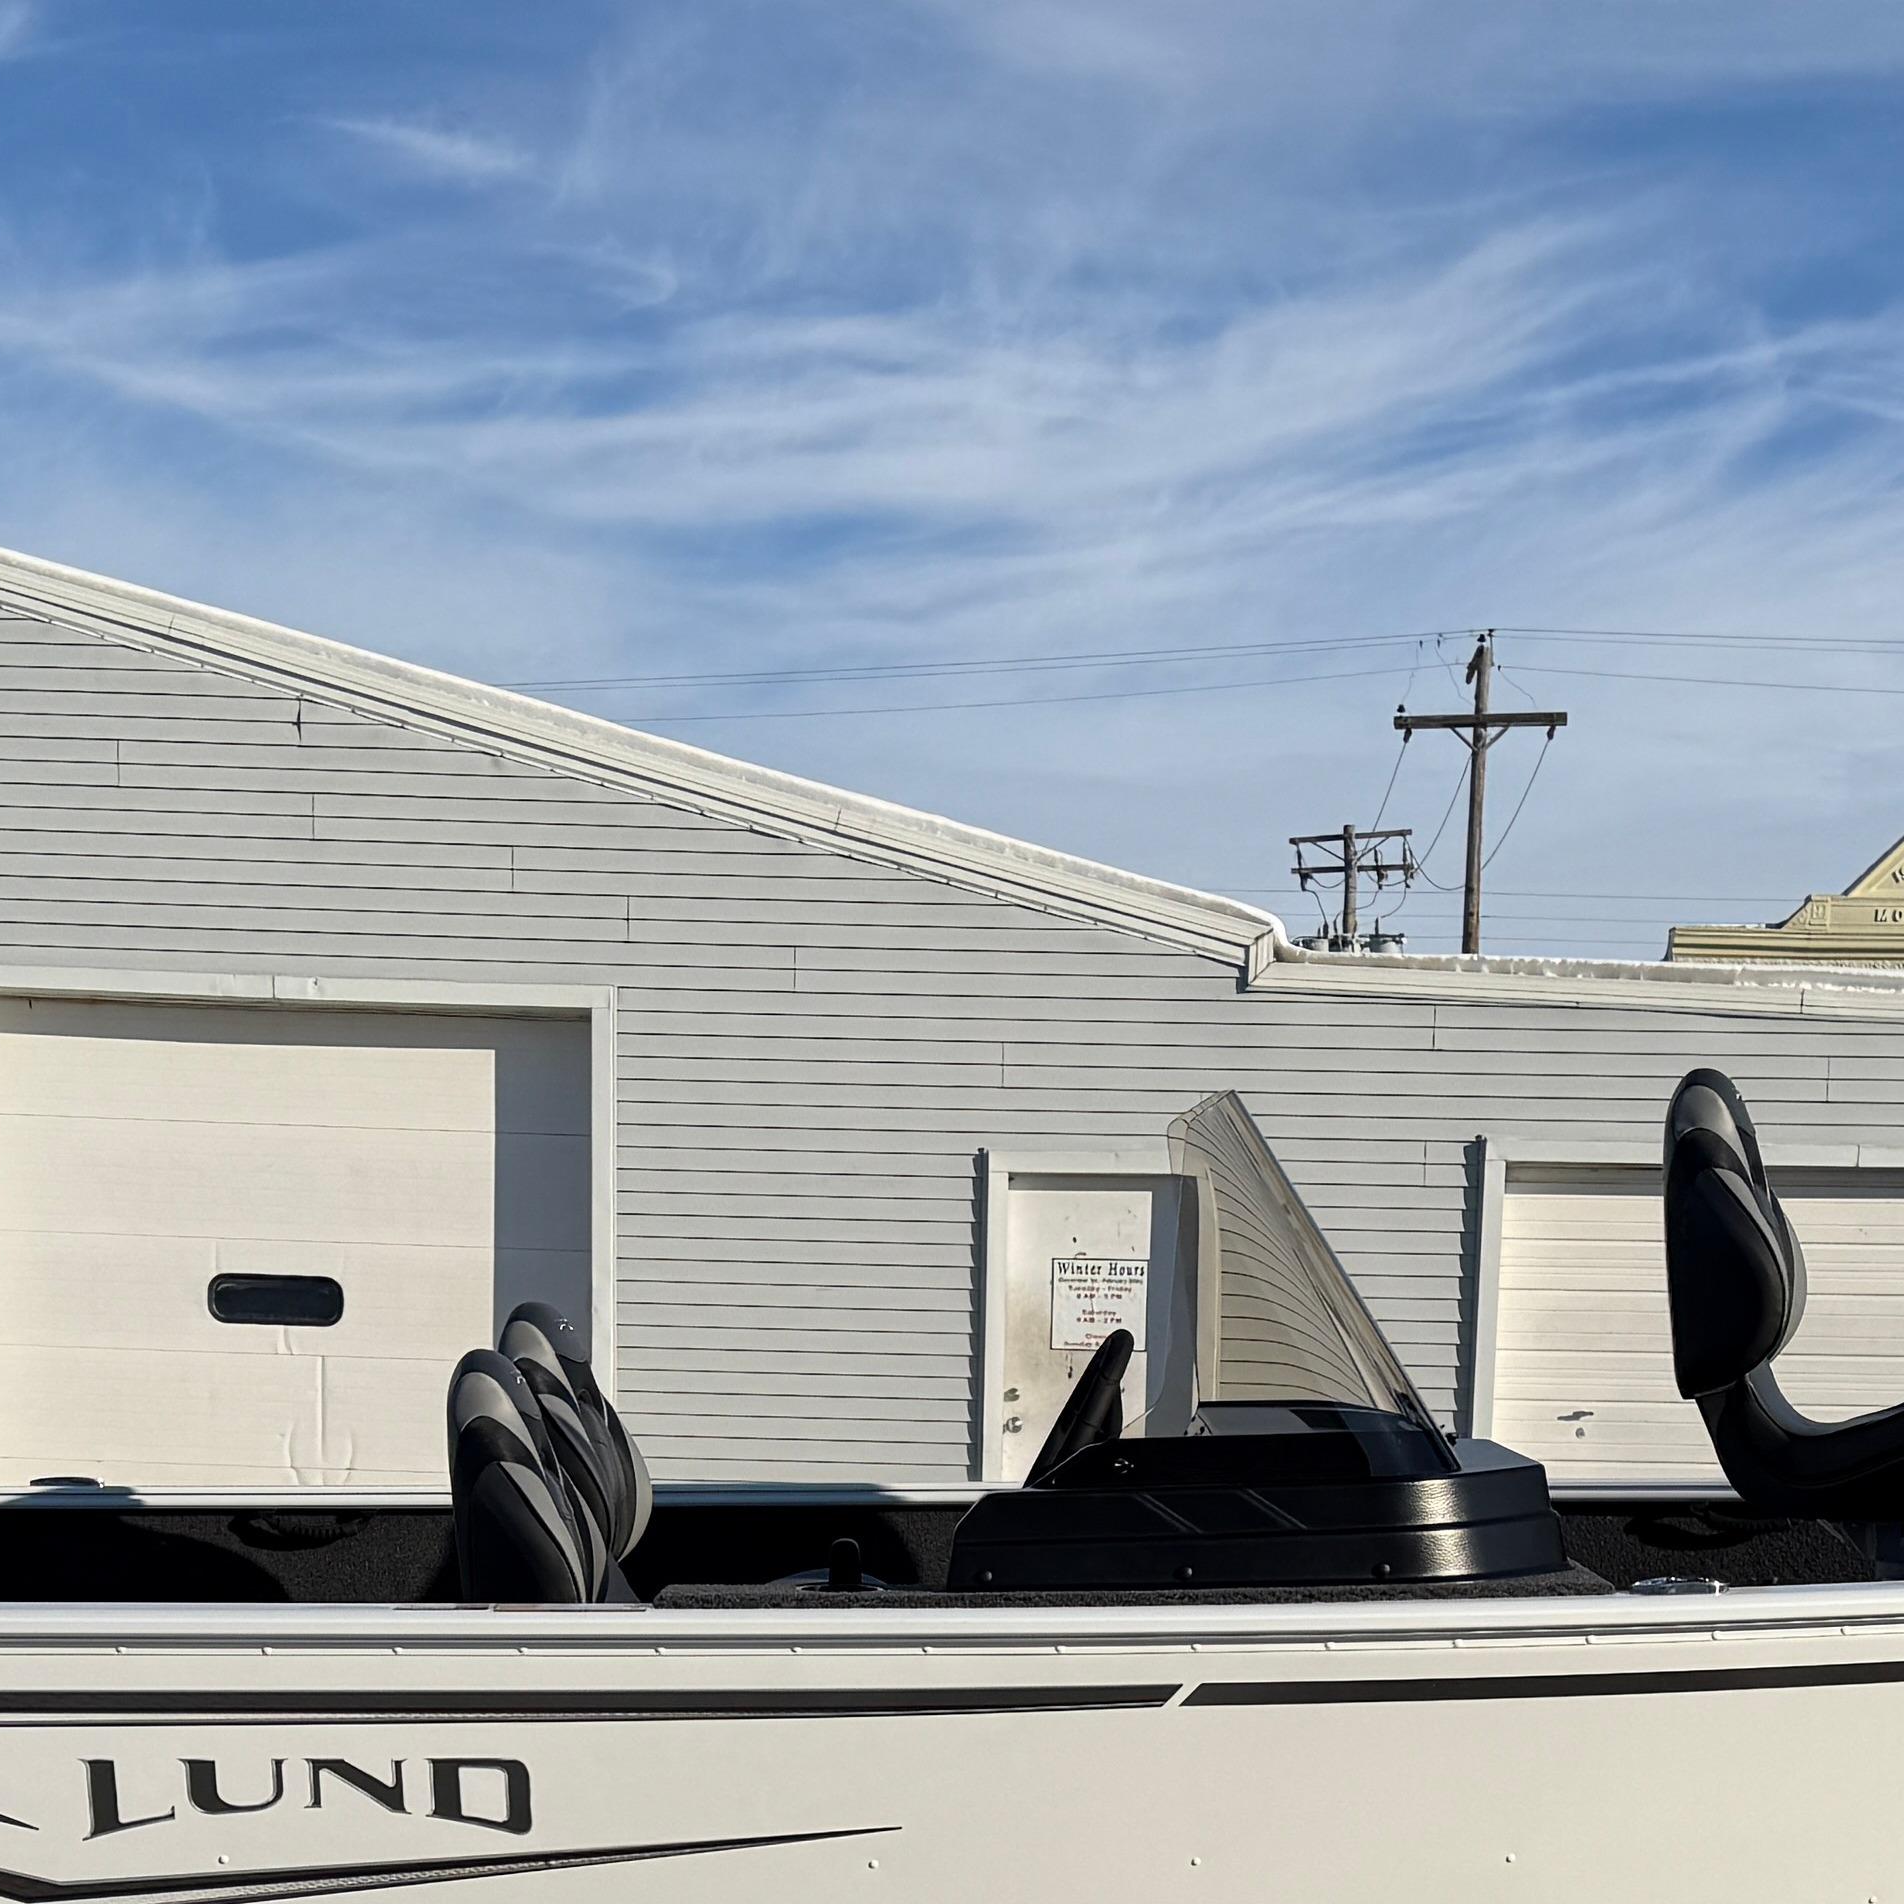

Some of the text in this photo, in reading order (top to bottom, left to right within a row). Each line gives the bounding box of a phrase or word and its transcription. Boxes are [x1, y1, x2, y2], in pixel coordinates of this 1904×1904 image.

[1057, 1261, 1145, 1277] Winter Hours
[79, 1757, 534, 1841] LUND
